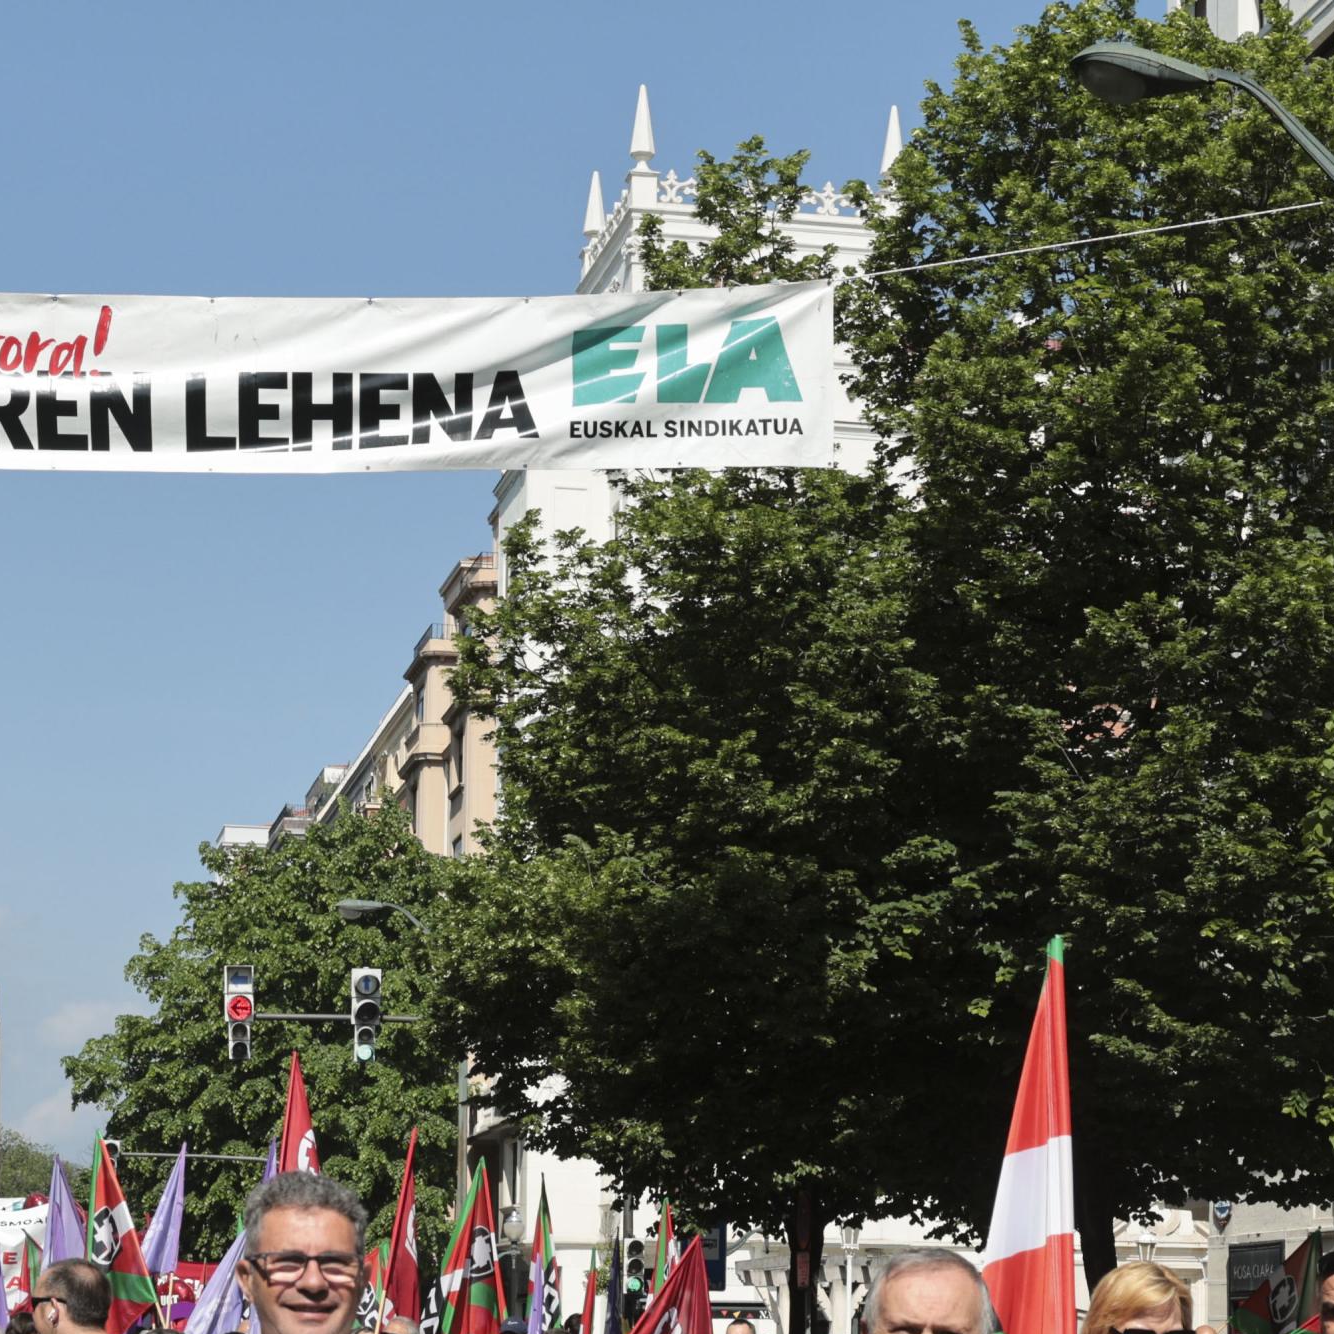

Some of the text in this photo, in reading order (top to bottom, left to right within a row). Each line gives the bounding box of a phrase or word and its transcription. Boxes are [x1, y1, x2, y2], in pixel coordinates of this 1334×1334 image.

[571, 315, 804, 407] ELA
[185, 369, 541, 454] LEHENA
[569, 418, 804, 439] EUSKAL SINDIKATUA
